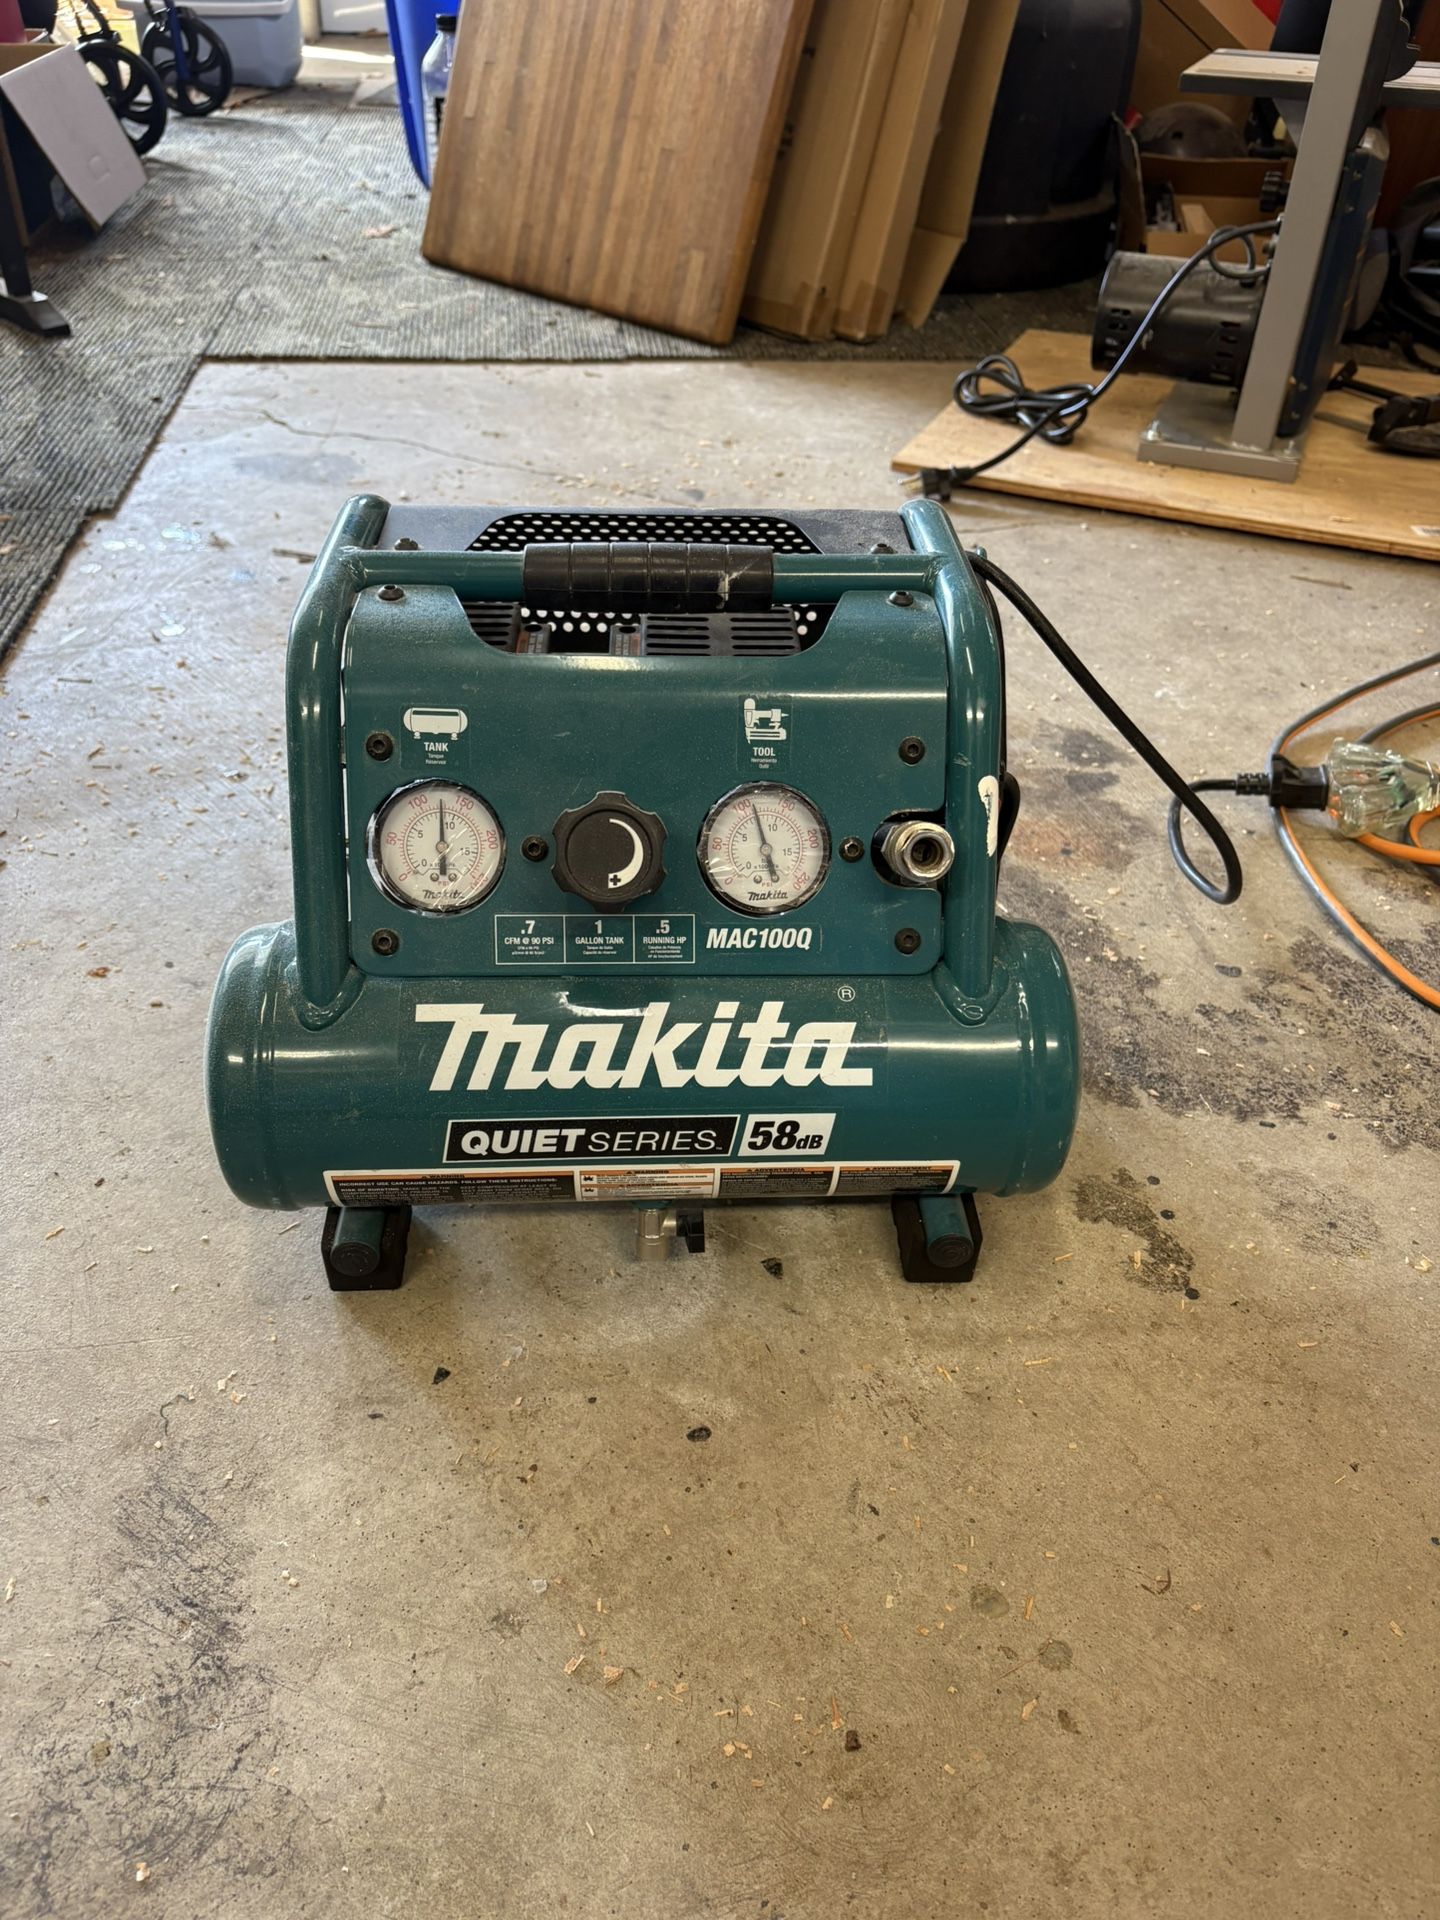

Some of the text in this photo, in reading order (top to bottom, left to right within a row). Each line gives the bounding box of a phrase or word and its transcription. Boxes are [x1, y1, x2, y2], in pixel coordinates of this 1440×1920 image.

[423, 741, 449, 752] TANK
[752, 746, 776, 757] TOOL
[408, 794, 428, 809] 100
[455, 795, 475, 811] 150
[733, 798, 752, 814] 100
[778, 799, 796, 812] 150
[445, 821, 456, 830] 10
[768, 823, 778, 832] 10
[386, 831, 398, 846] 50
[417, 830, 424, 839] 5
[486, 829, 498, 850] 200
[742, 833, 748, 842] 5
[807, 828, 820, 849] 200
[712, 837, 723, 851] 50
[782, 847, 793, 857] 15
[421, 858, 428, 867] 0
[745, 861, 752, 870] 0
[398, 872, 409, 882] 0
[724, 876, 734, 886] 0
[793, 871, 811, 891] 250
[520, 920, 536, 935] .7
[594, 920, 603, 934] 1
[655, 920, 671, 934] .5
[504, 937, 521, 945] CFM
[531, 937, 541, 945] 90
[542, 937, 555, 945] PSI
[575, 936, 625, 945] GALLON TANK
[642, 936, 687, 945] RUNNING HP
[705, 927, 813, 950] MAC100Q
[747, 1120, 823, 1150] 58dB
[460, 1128, 718, 1156] QUIET SERIES
